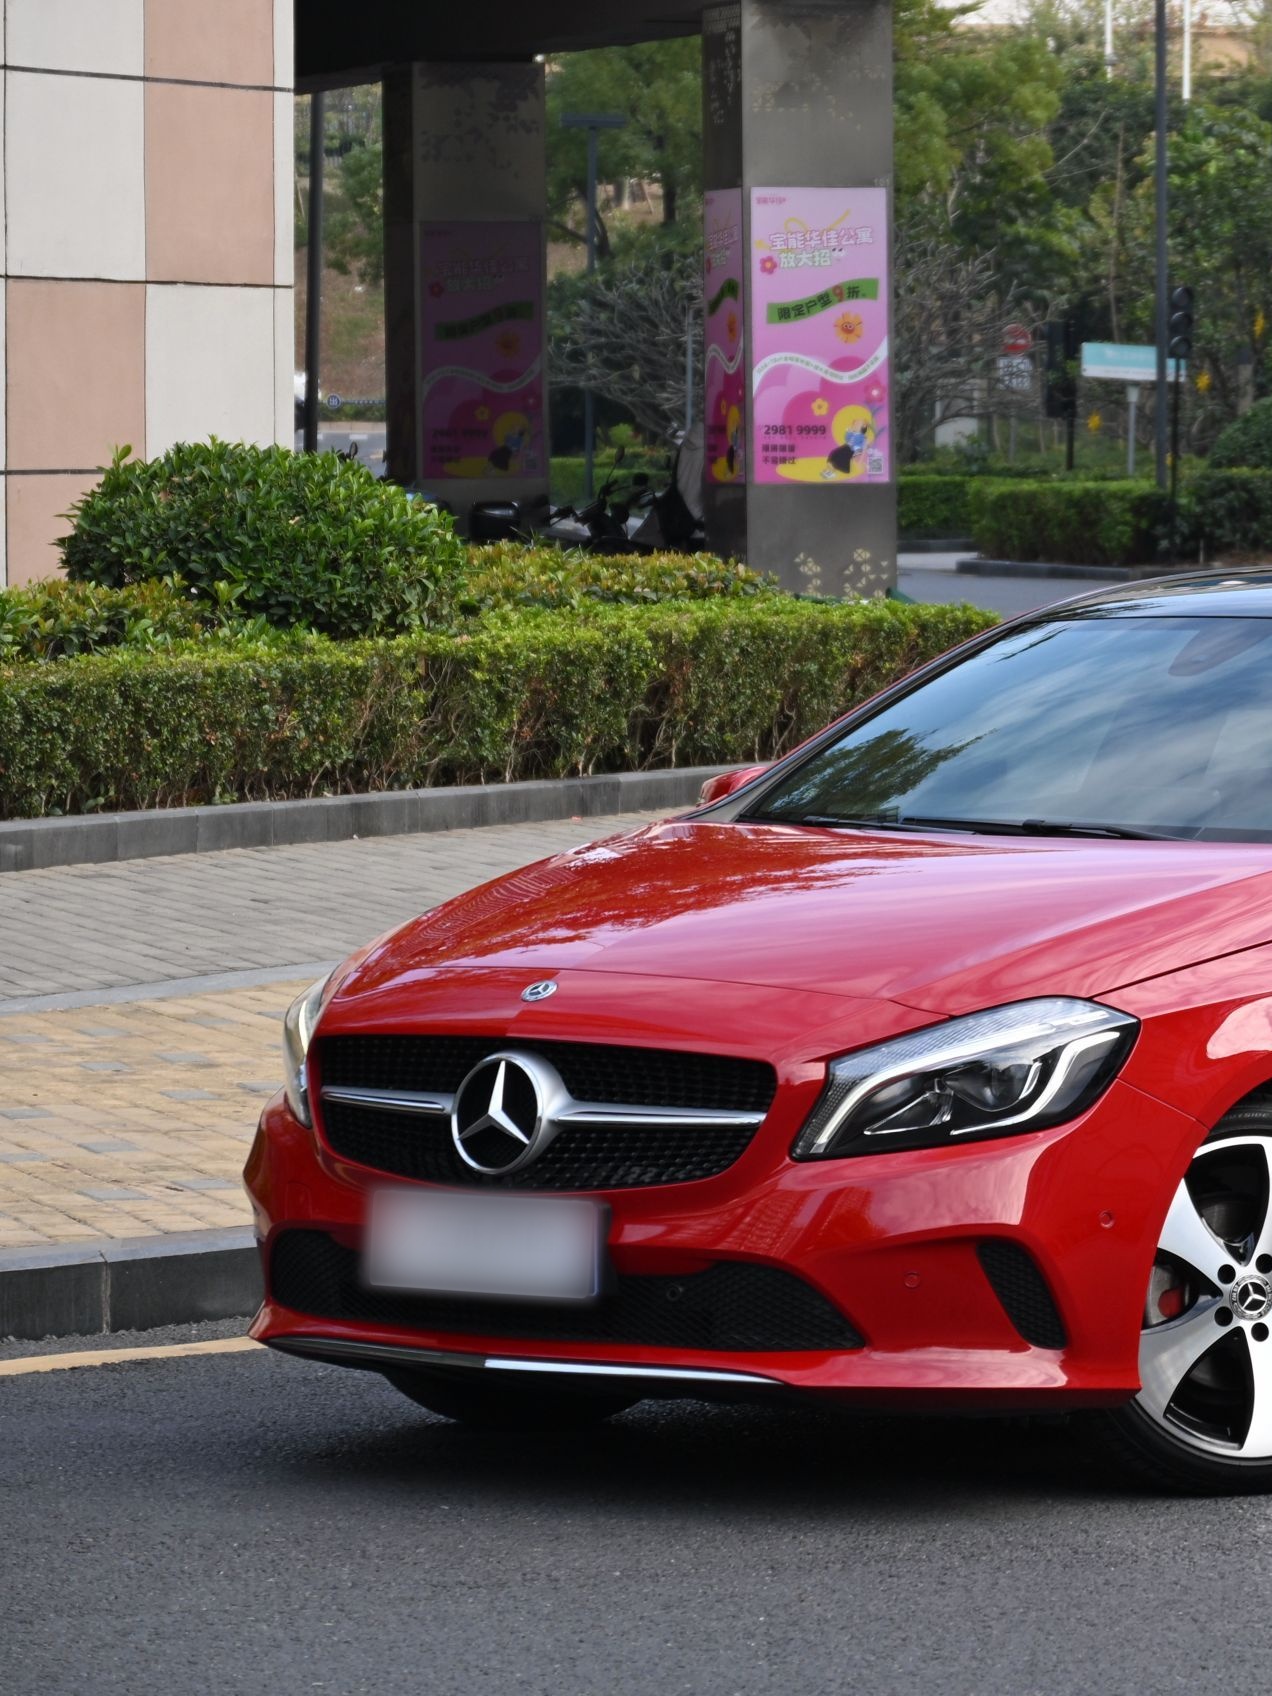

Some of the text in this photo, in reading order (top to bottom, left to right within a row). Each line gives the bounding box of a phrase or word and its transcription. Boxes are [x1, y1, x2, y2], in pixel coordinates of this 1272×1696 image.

[769, 227, 873, 250] 宝能华佳公寓
[778, 249, 832, 269] 放大招
[764, 424, 827, 435] 2981 9999
